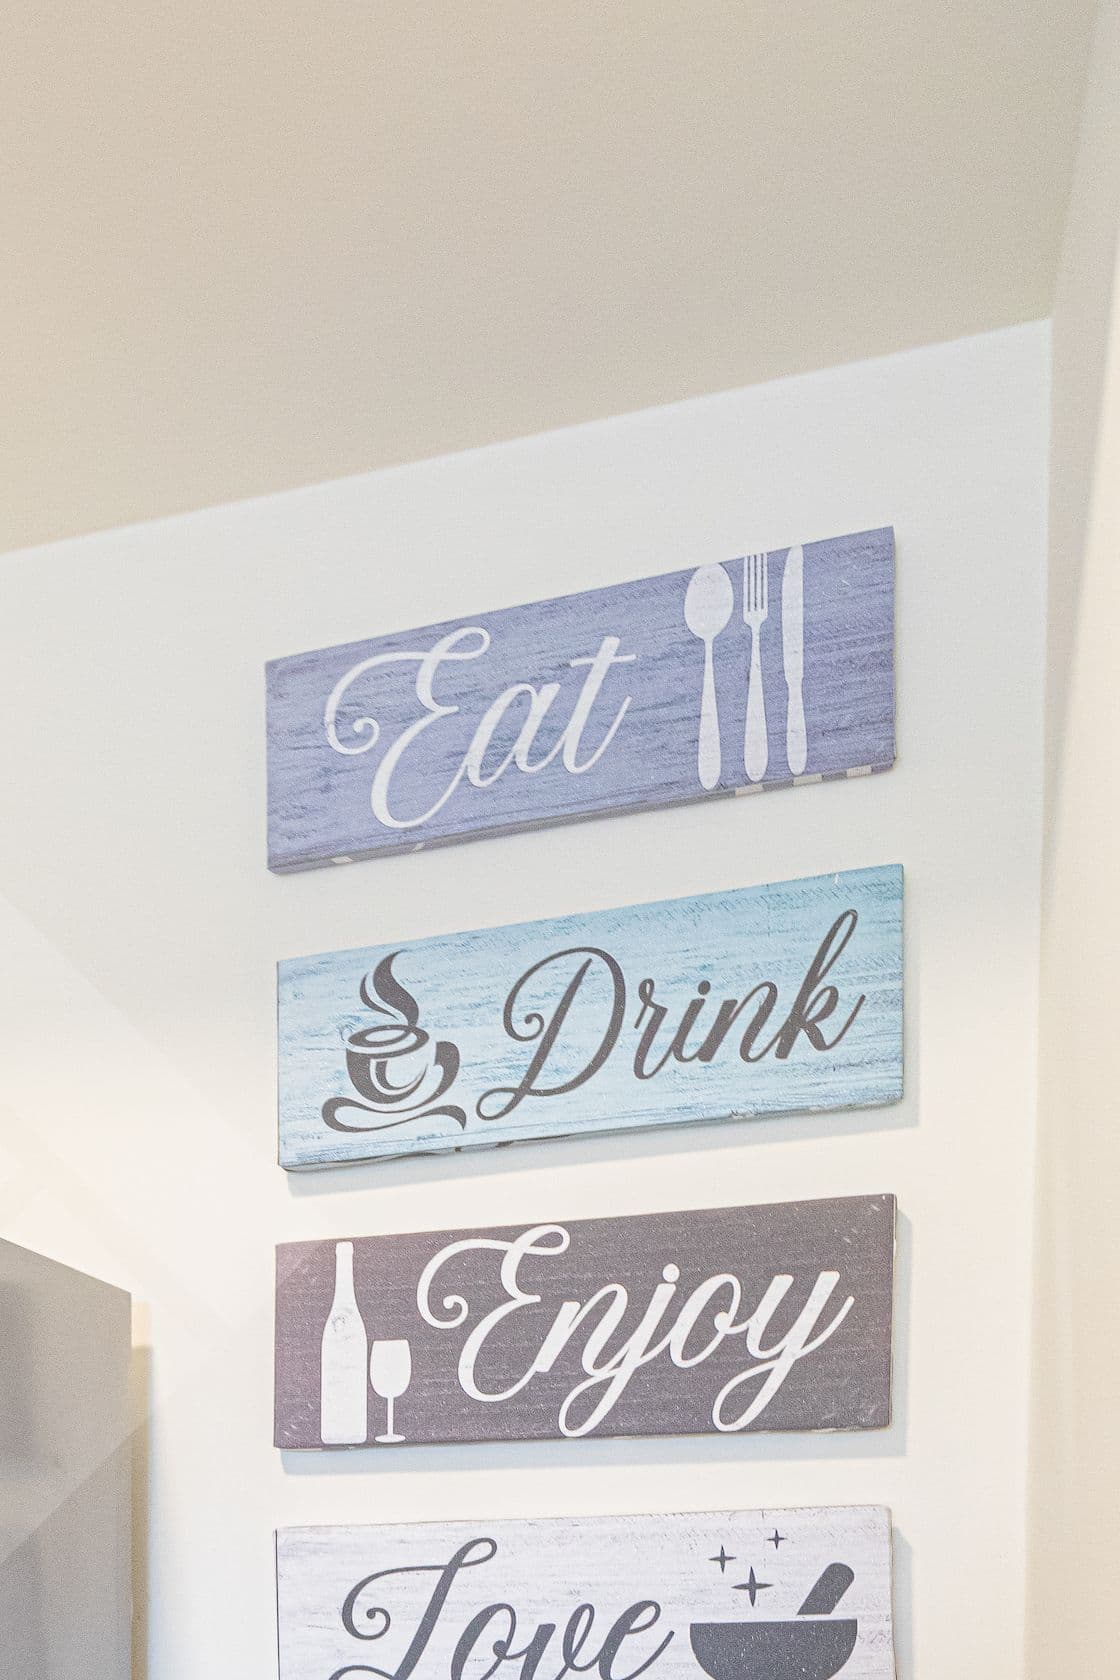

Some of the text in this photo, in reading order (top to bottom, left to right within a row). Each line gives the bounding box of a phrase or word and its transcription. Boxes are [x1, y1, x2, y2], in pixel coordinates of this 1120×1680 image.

[325, 626, 637, 830] Eat
[475, 908, 866, 1121] Drink
[416, 1224, 855, 1437] Enjoy
